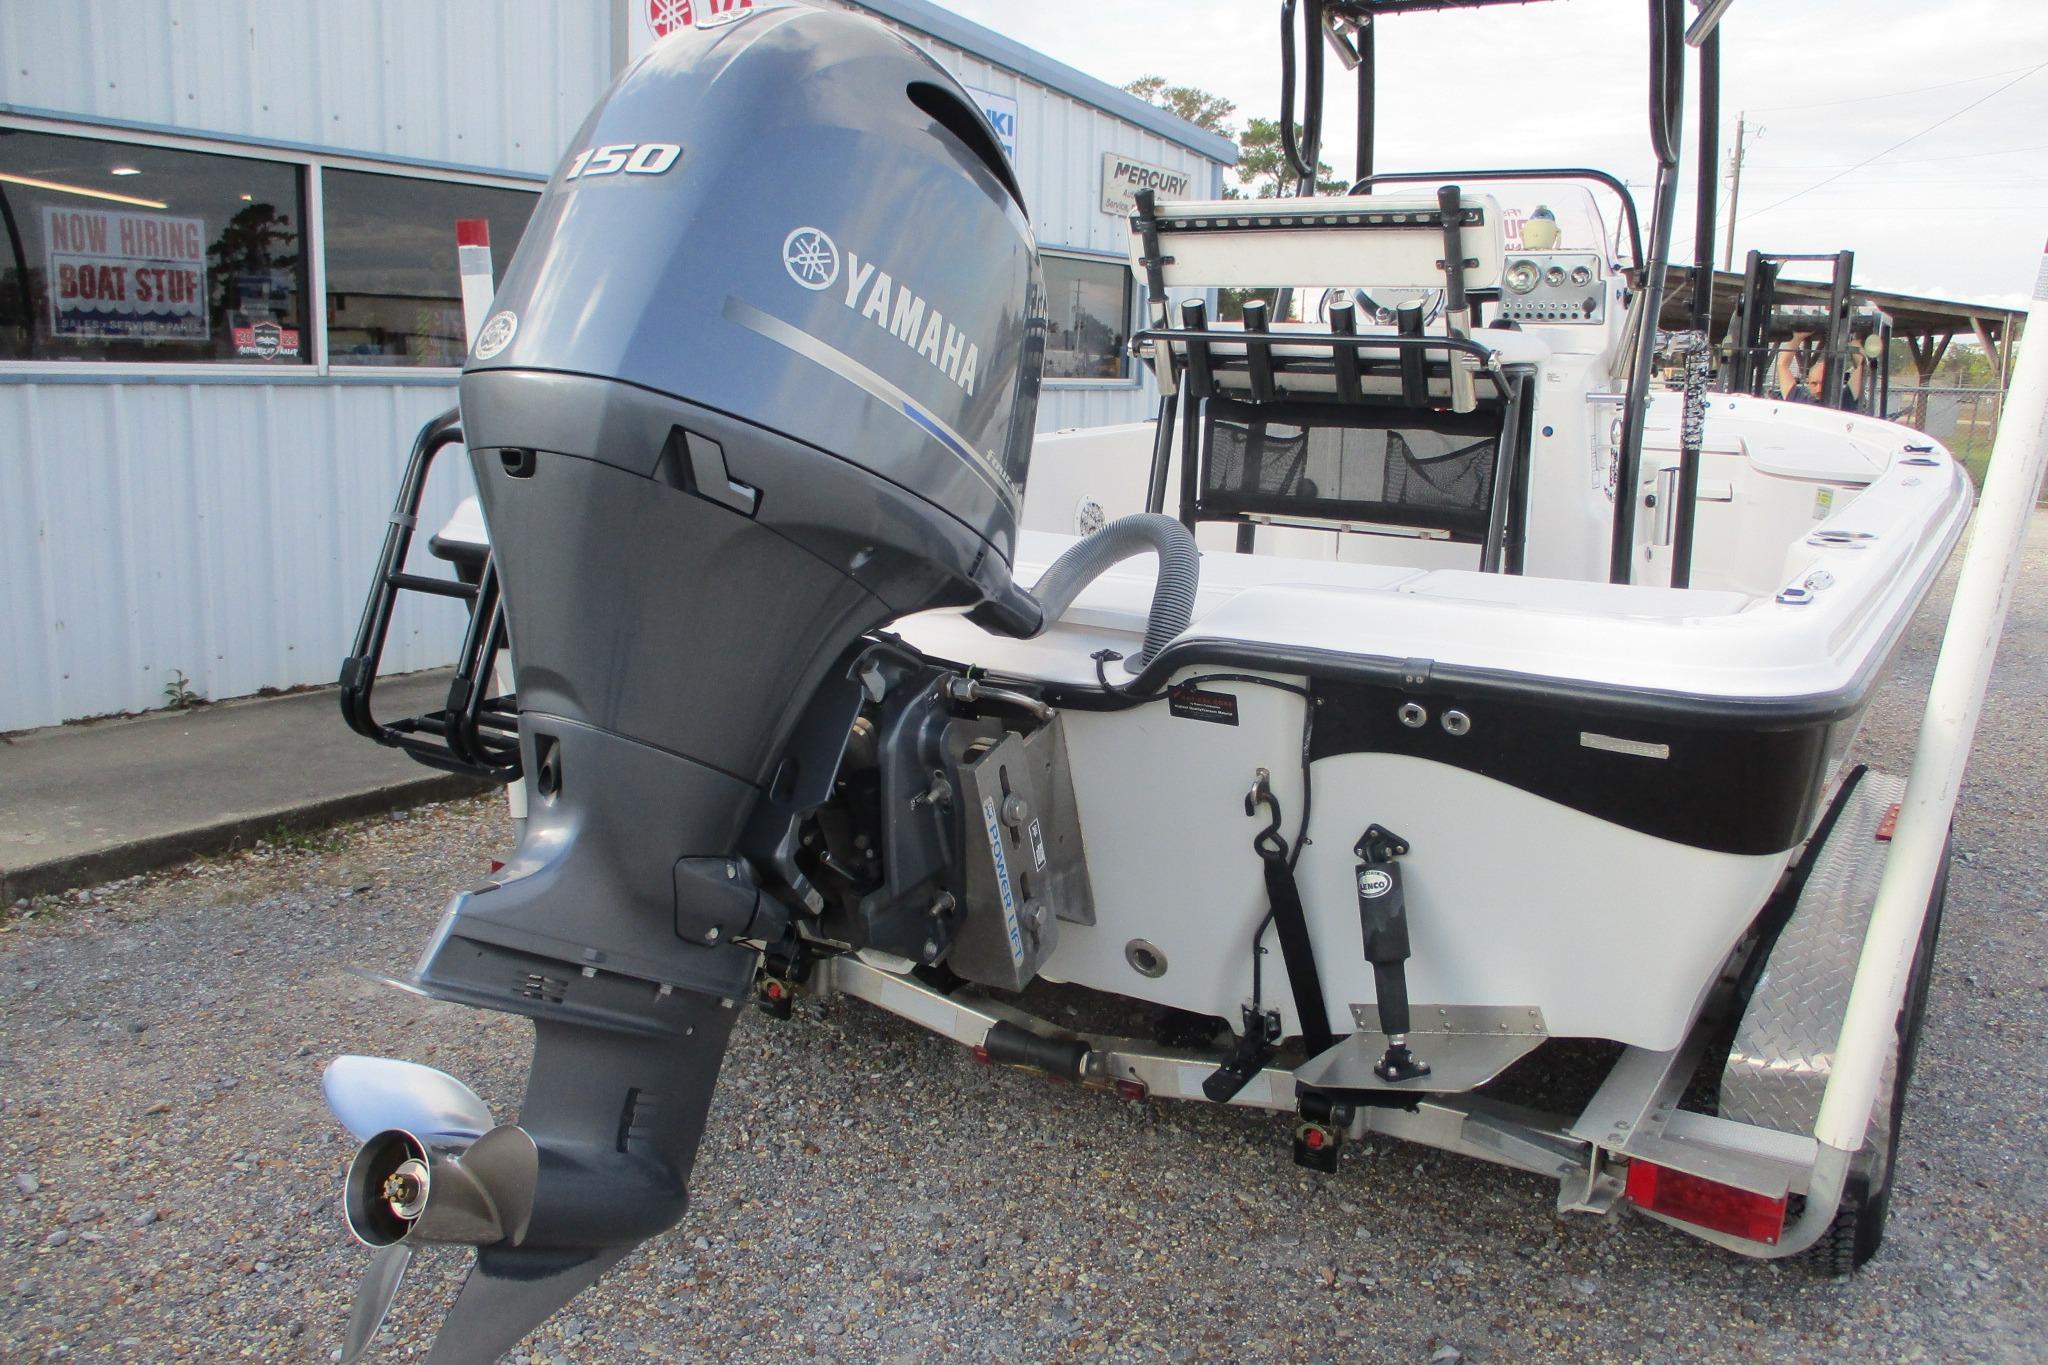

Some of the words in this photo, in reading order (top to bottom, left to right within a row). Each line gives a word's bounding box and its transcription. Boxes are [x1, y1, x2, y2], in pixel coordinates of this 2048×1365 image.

[566, 143, 681, 181] 150
[1114, 162, 1188, 196] MERCURY
[51, 212, 107, 253] NOW
[120, 218, 200, 260] HIRING
[59, 263, 128, 302] BOAT
[135, 267, 198, 304] STUF
[845, 251, 979, 398] YAMAHA
[989, 823, 1012, 910] POWER
[1008, 914, 1023, 960] LIFT
